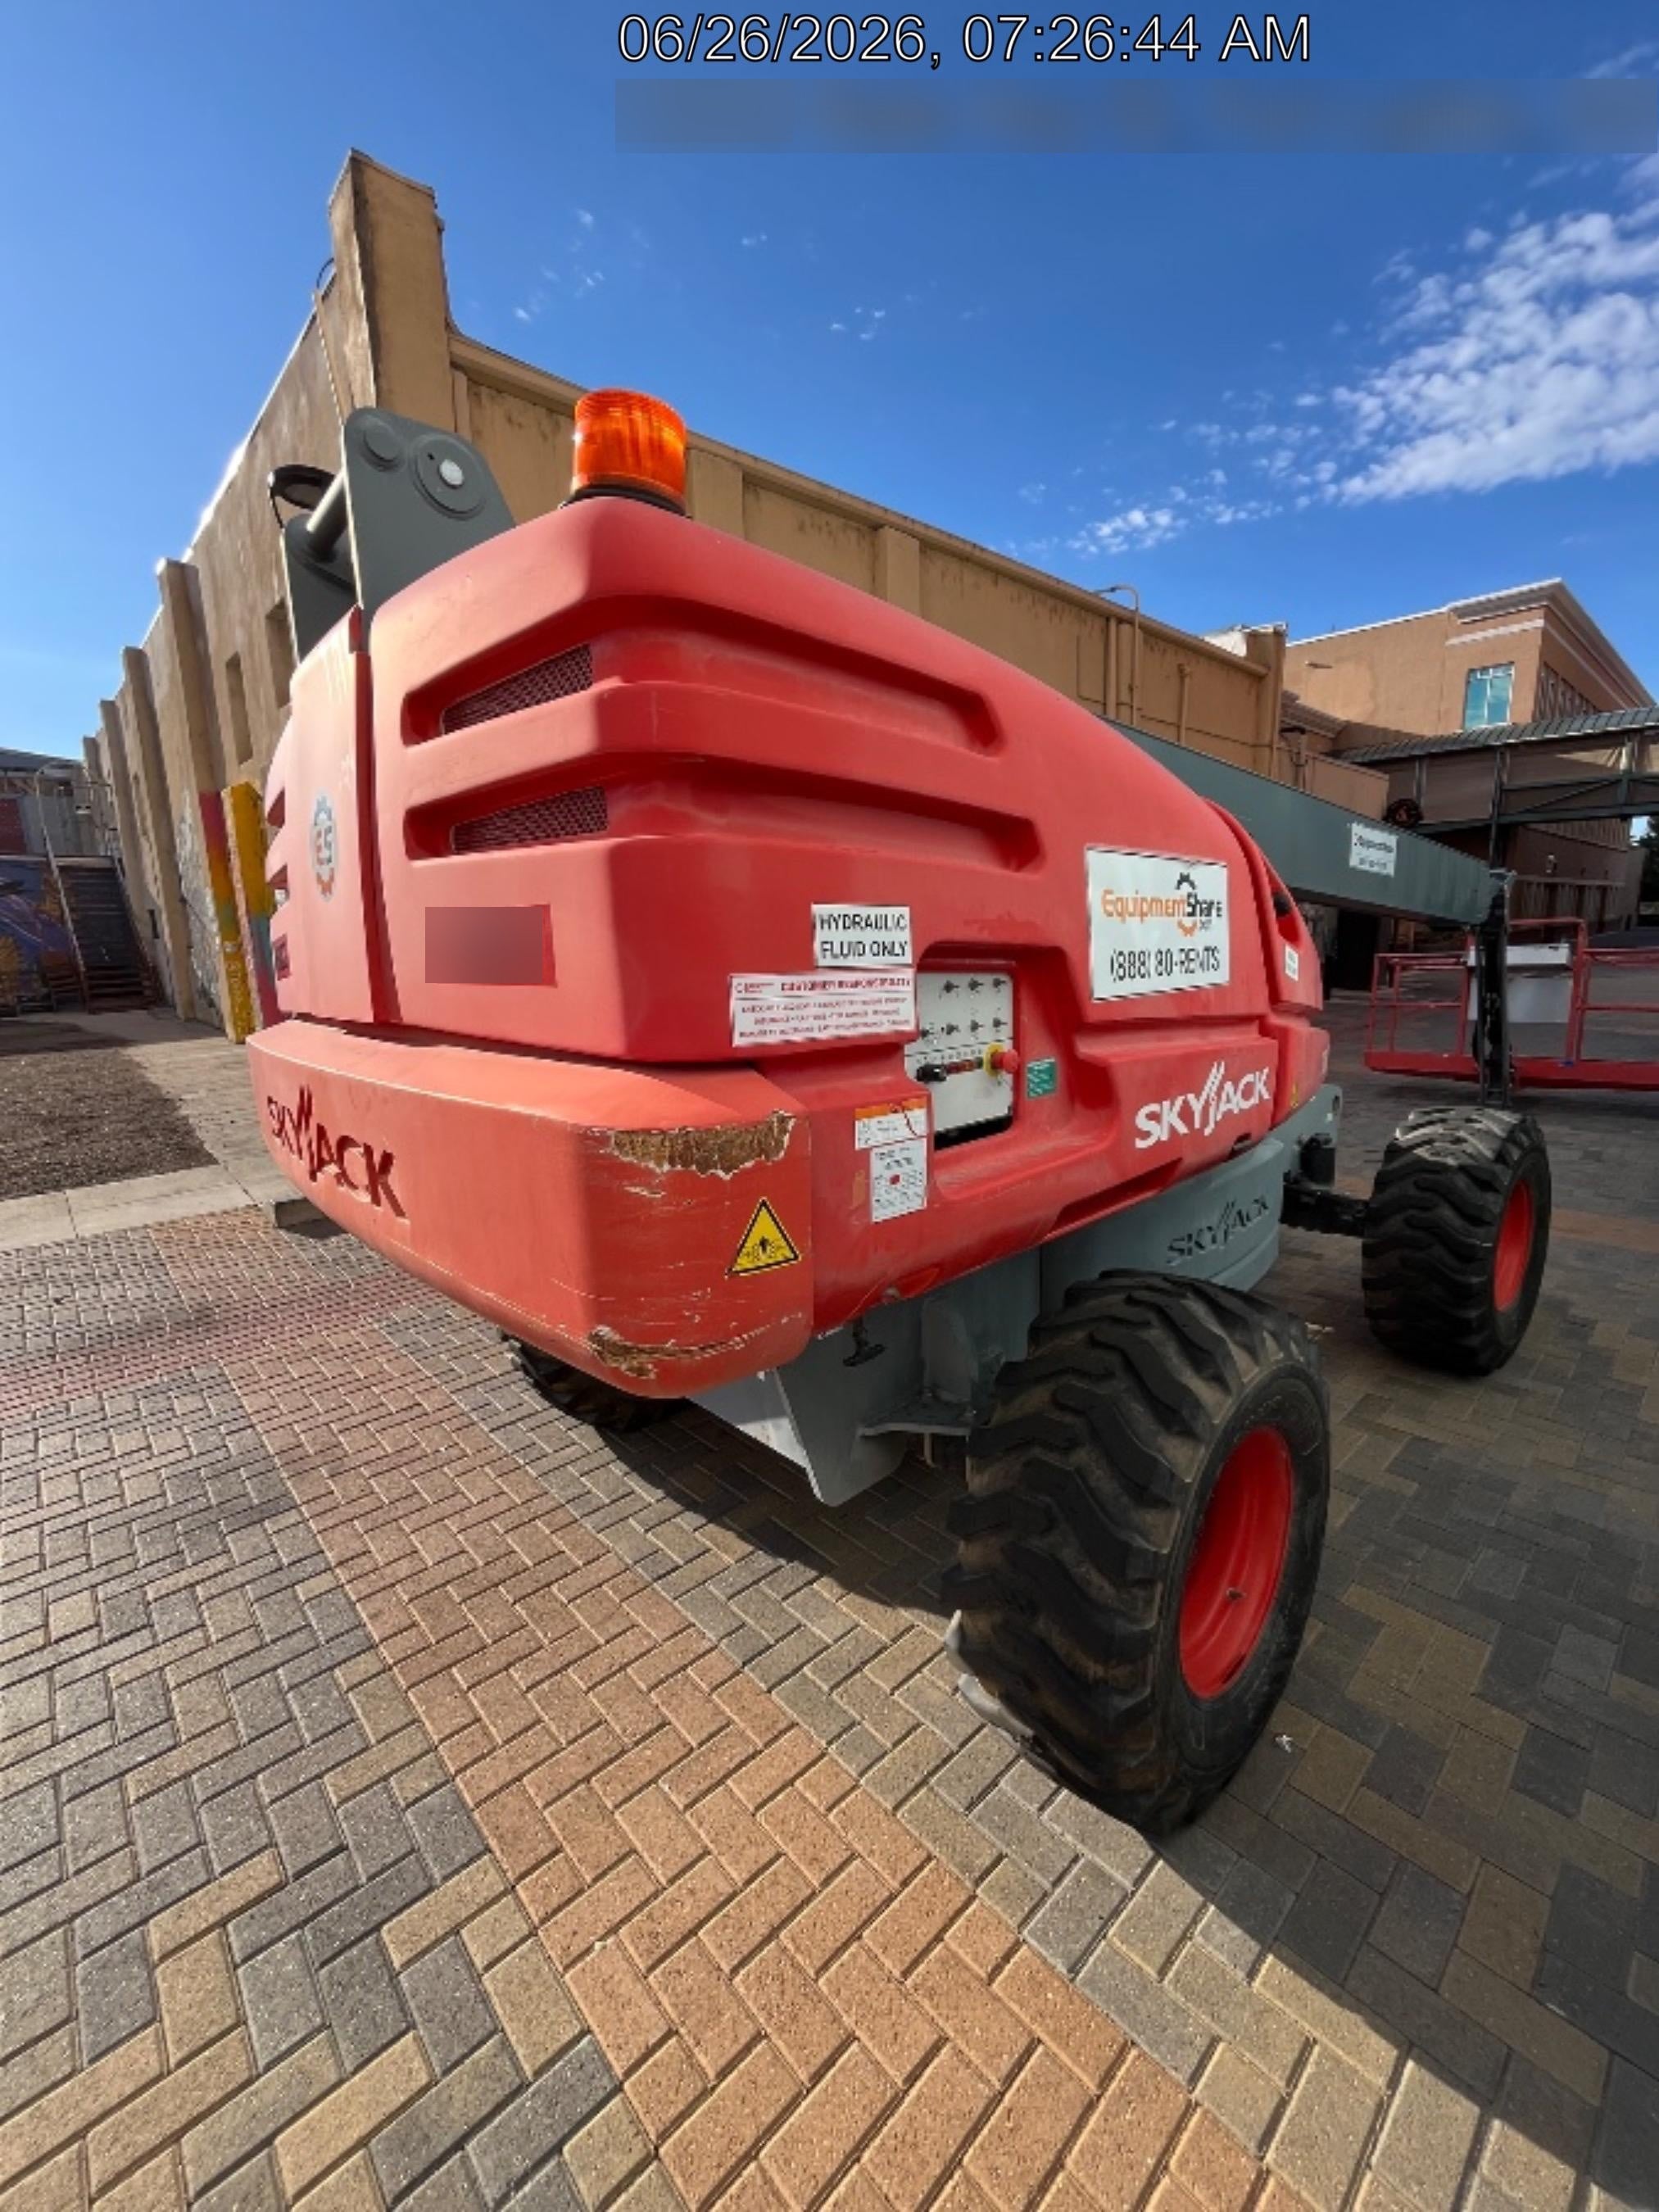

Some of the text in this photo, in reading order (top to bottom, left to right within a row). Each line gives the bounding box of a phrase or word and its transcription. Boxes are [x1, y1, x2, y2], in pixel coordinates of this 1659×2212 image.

[819, 913, 908, 931] HYDRAULIC
[1101, 888, 1222, 923] EquipmentShare
[820, 940, 908, 959] FLUID ONLY
[1154, 945, 1220, 977] 80-RENTS
[1135, 1061, 1271, 1149] SKYJACK
[267, 1085, 406, 1218] SKYJACK
